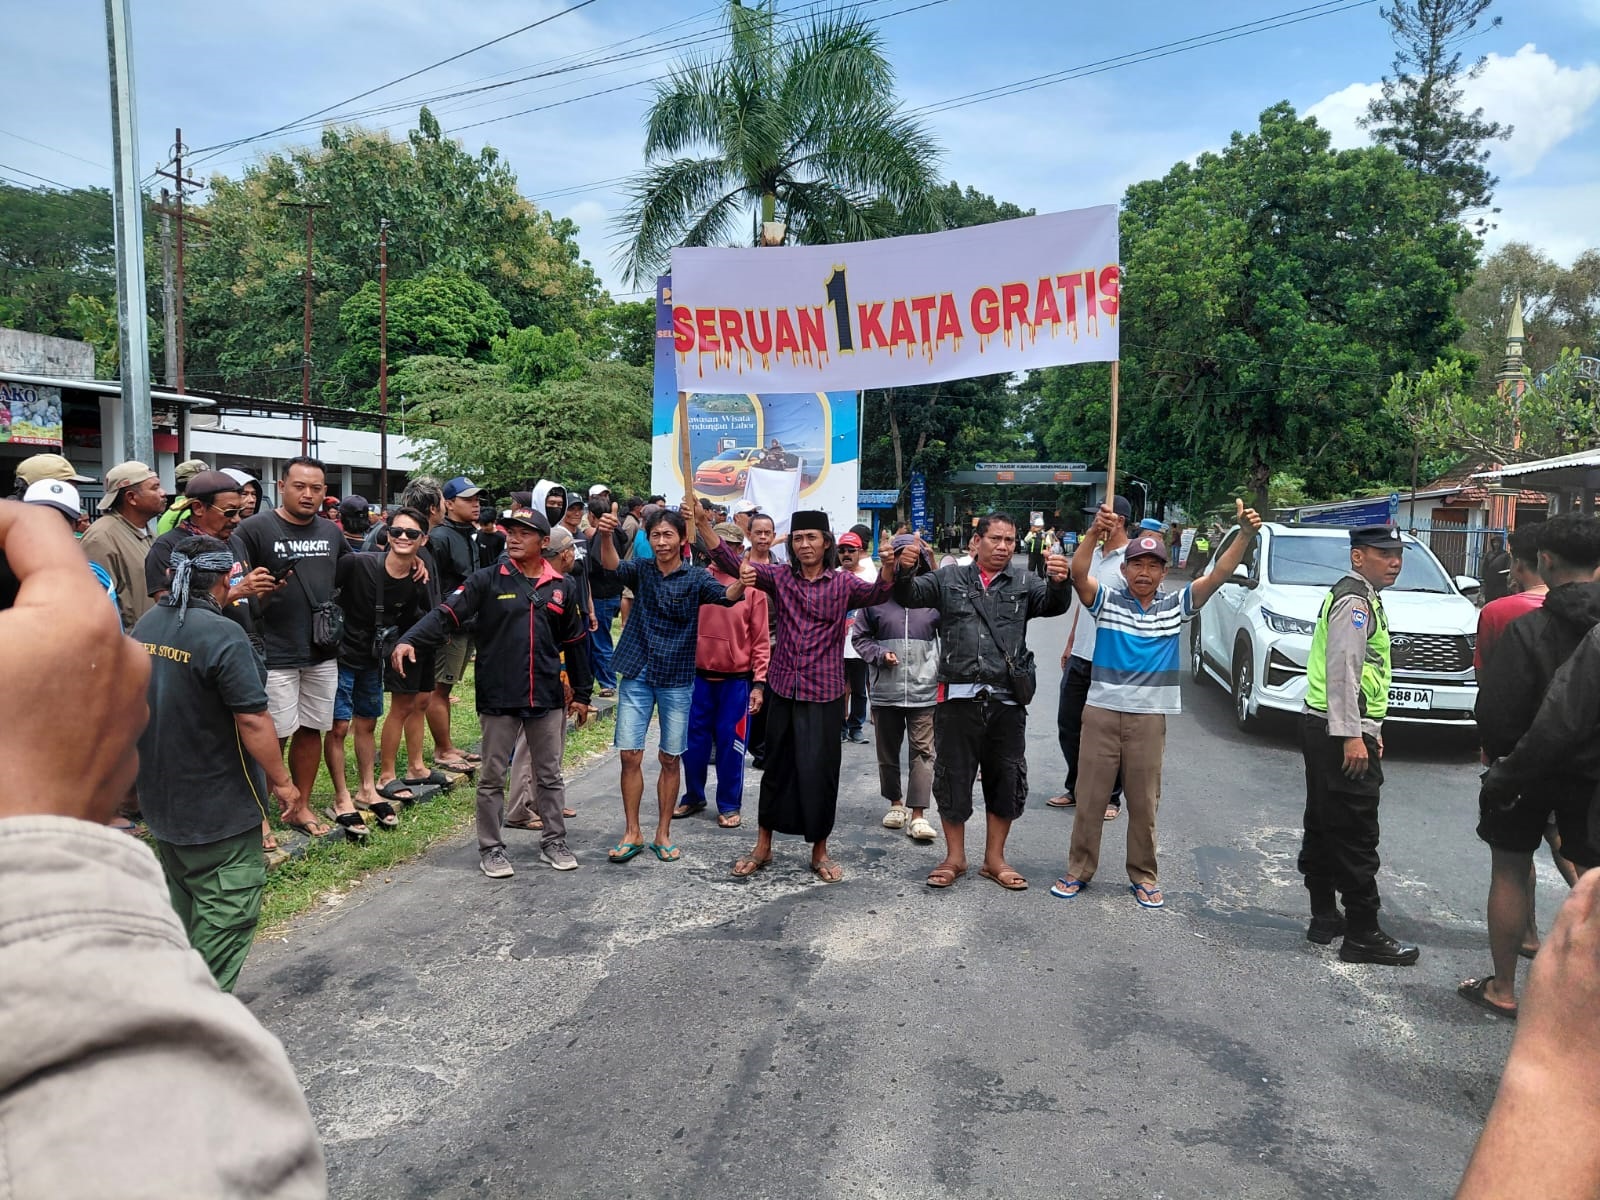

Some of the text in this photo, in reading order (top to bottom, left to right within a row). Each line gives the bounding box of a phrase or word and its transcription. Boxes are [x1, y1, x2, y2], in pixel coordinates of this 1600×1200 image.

[673, 263, 1120, 378] SERUAN 1 KATA GRATIS
[721, 415, 751, 423] Wisata
[158, 645, 191, 663] STOUT
[1414, 692, 1429, 703] DA
